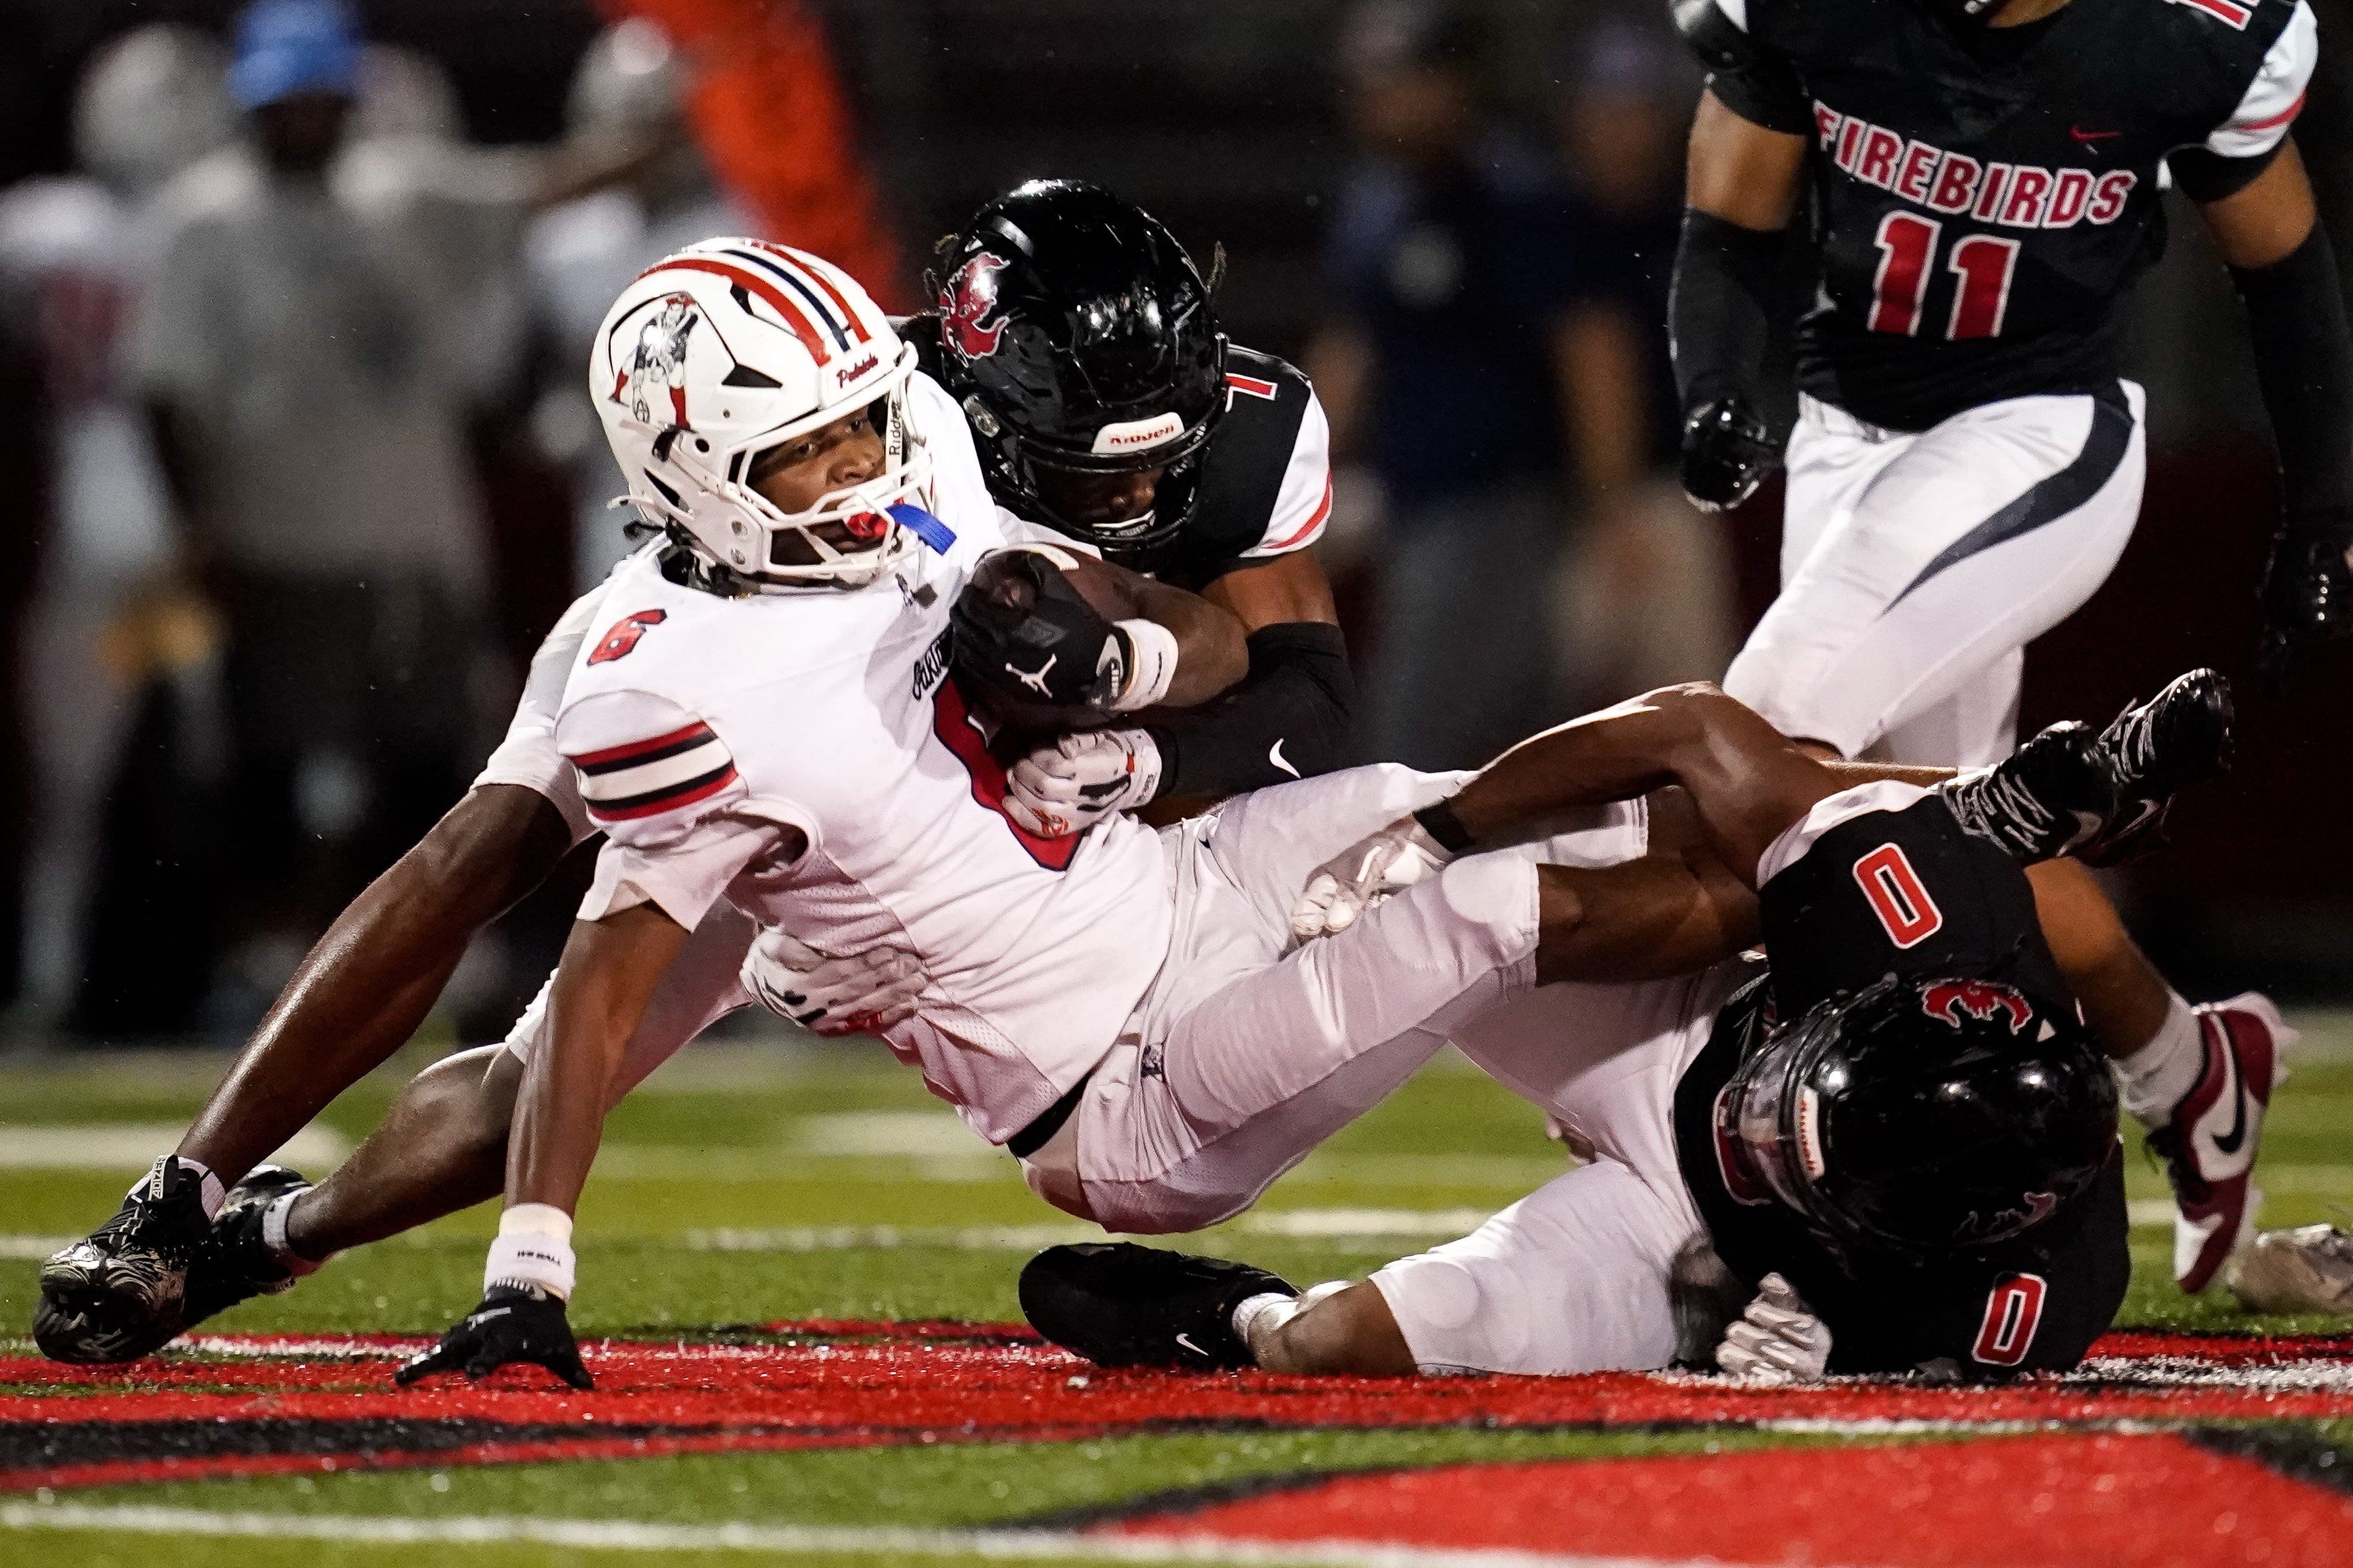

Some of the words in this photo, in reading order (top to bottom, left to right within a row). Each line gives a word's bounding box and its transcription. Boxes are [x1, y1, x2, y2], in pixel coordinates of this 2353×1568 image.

[1812, 100, 2138, 229] FIREBIRDS
[1866, 209, 2022, 341] 11
[888, 402, 901, 455] Ridd
[586, 608, 668, 667] 6
[1854, 841, 1942, 950] 0
[151, 1155, 166, 1200] ADIZER
[1972, 1272, 2047, 1367] 0
